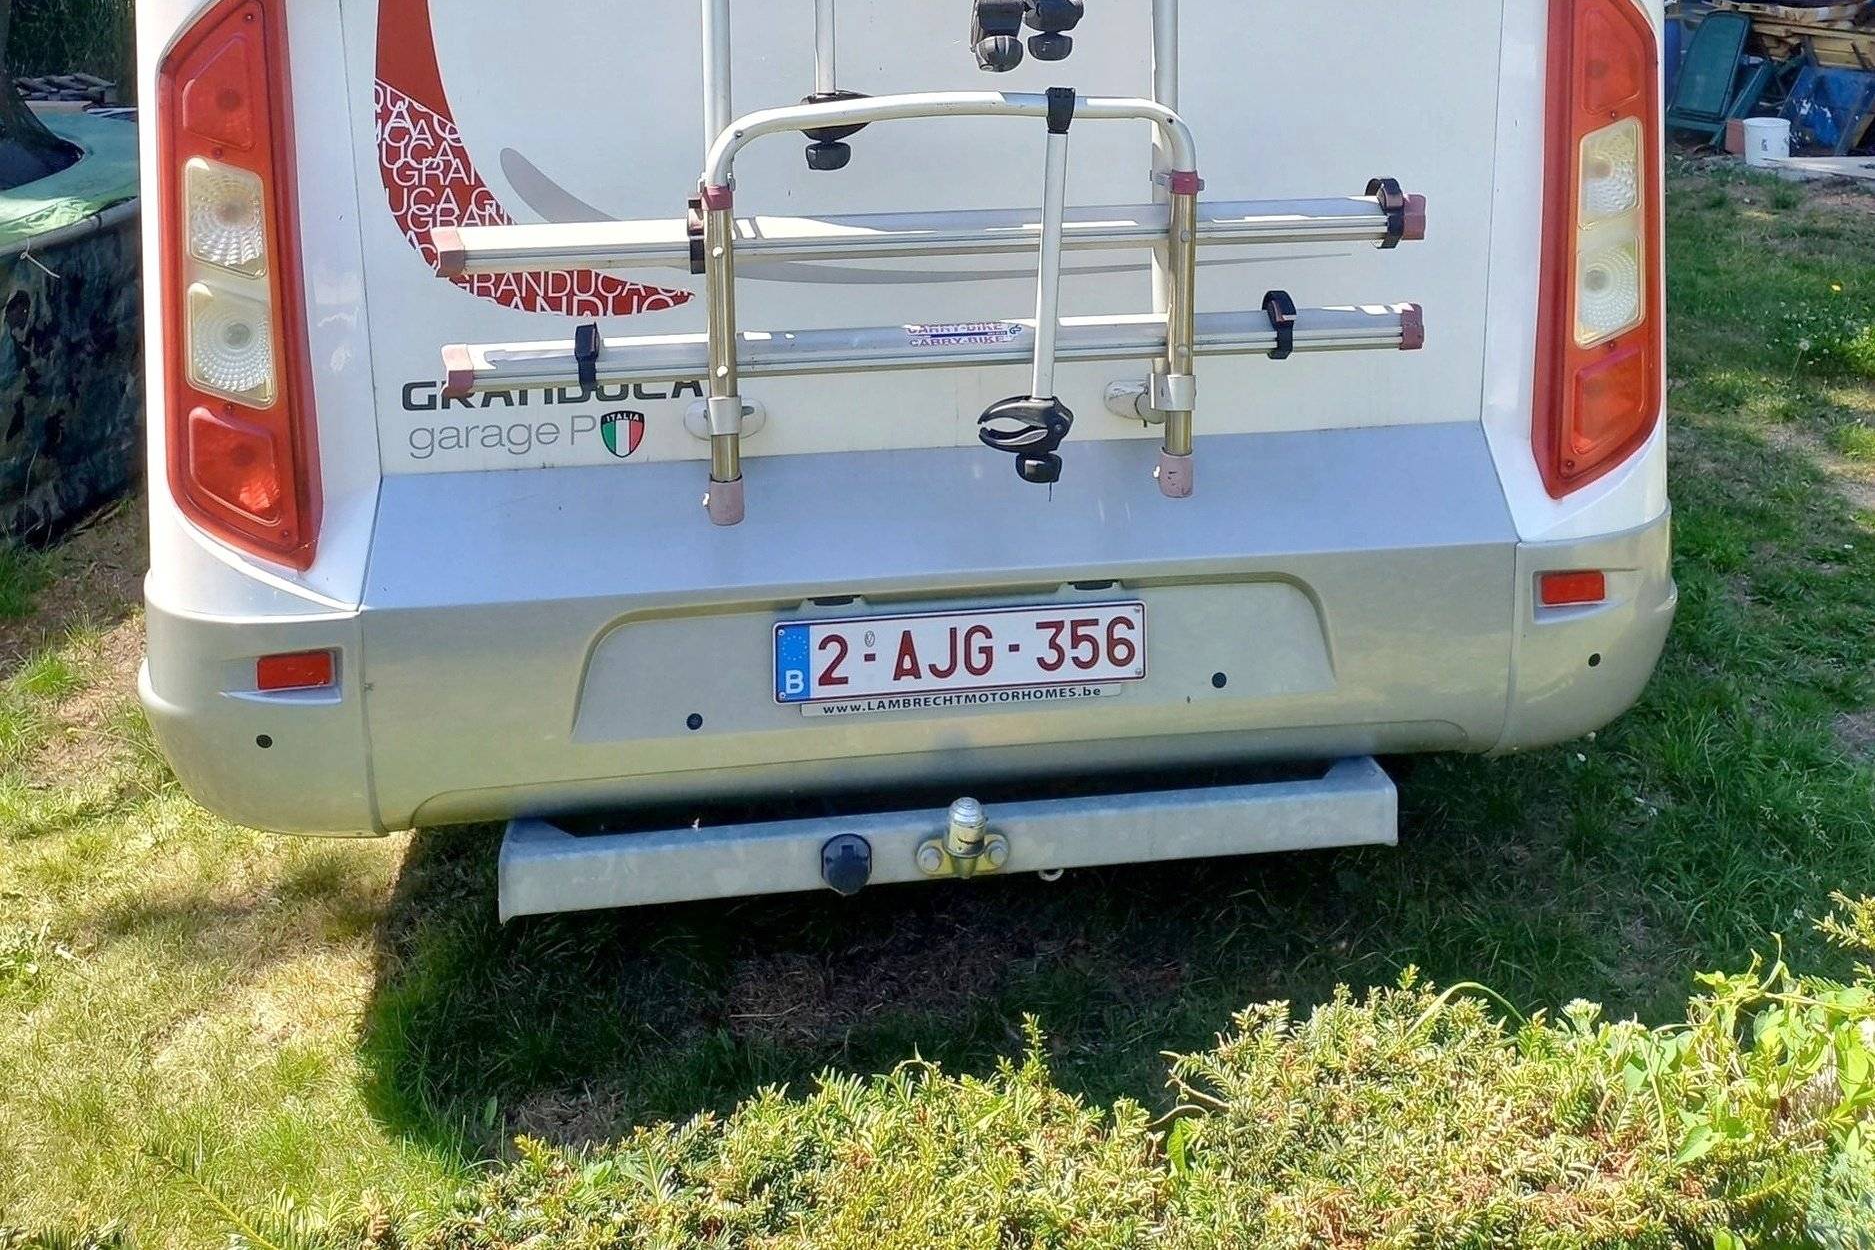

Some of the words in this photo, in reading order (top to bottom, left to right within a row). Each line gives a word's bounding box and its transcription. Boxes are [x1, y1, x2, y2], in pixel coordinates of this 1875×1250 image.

[606, 412, 640, 422] ITALIA
[408, 420, 561, 460] garage
[570, 414, 598, 448] P
[784, 669, 805, 695] B
[822, 686, 1101, 714] www.LAMBRECHTMOTORHOMES.be
